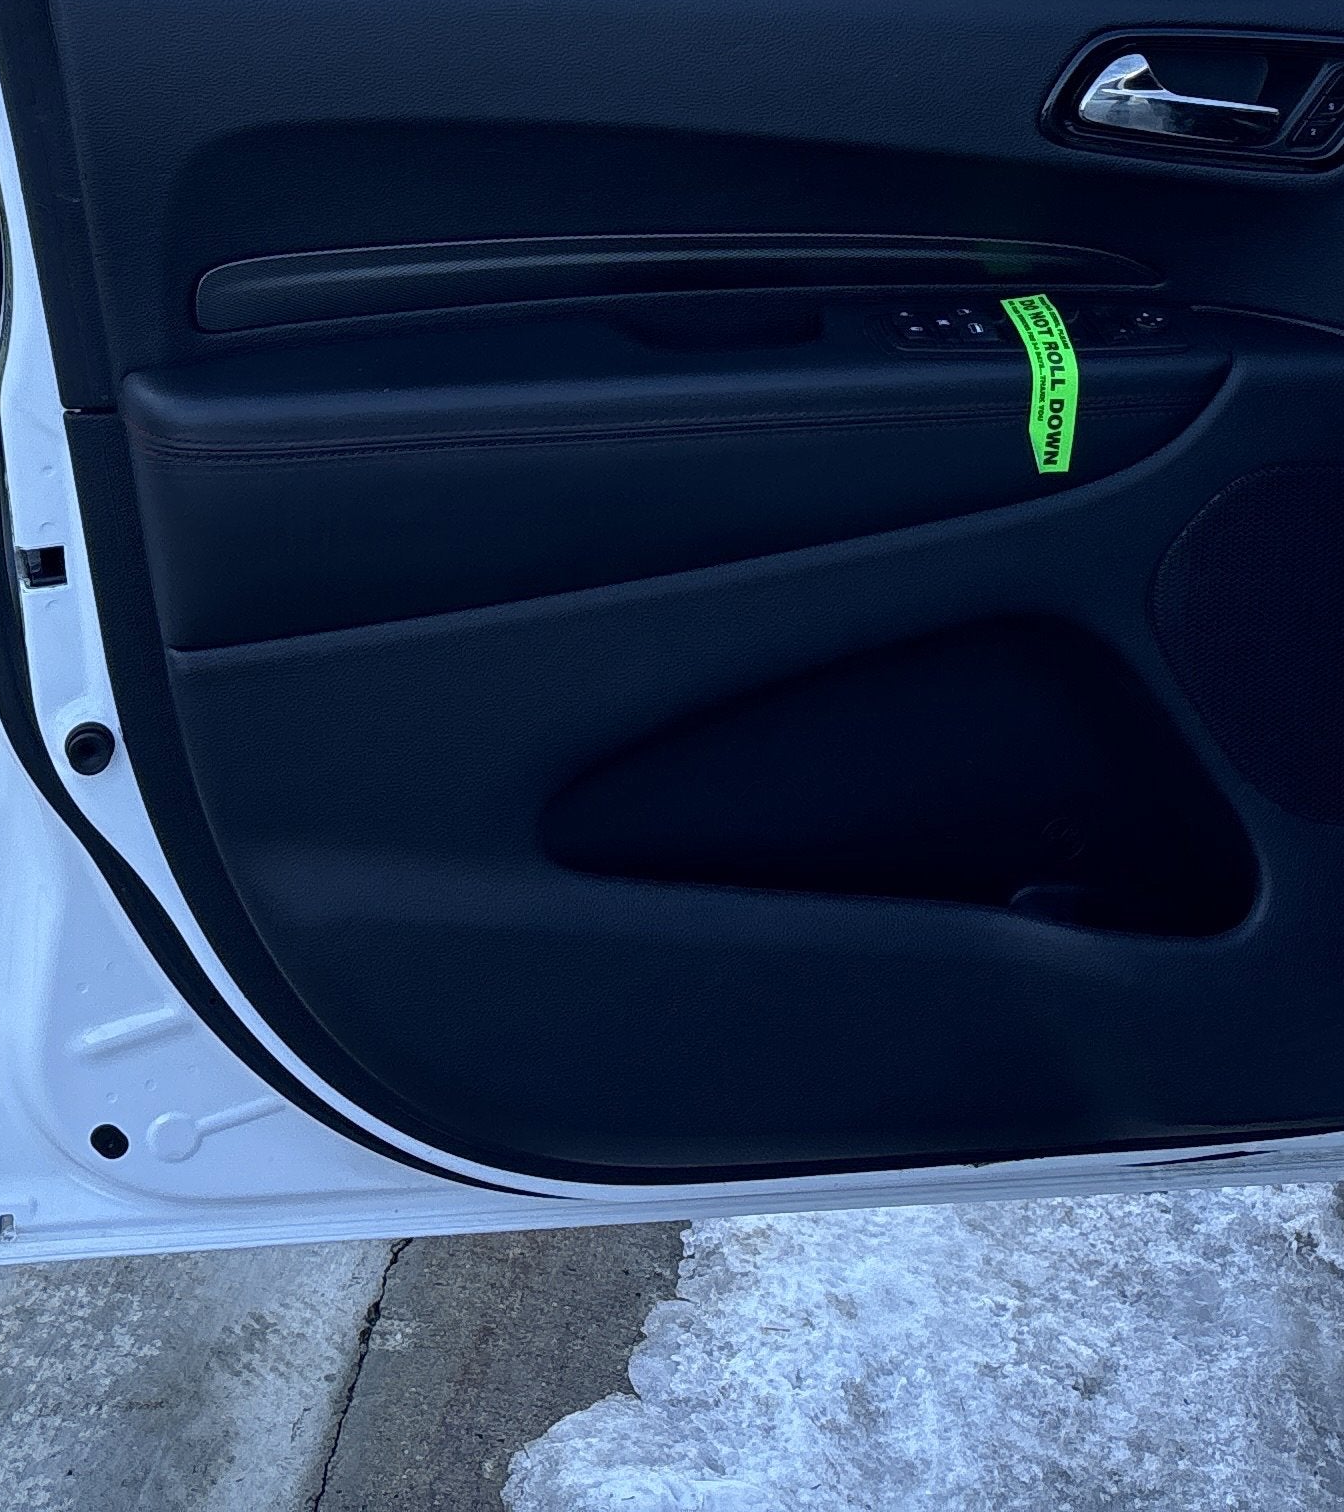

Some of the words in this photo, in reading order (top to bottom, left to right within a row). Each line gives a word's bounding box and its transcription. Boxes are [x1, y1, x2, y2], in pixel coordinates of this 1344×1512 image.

[1019, 299, 1037, 311] DO
[1030, 312, 1055, 338] NOT
[1042, 340, 1066, 392] ROLL
[1042, 398, 1065, 466] DOWN
